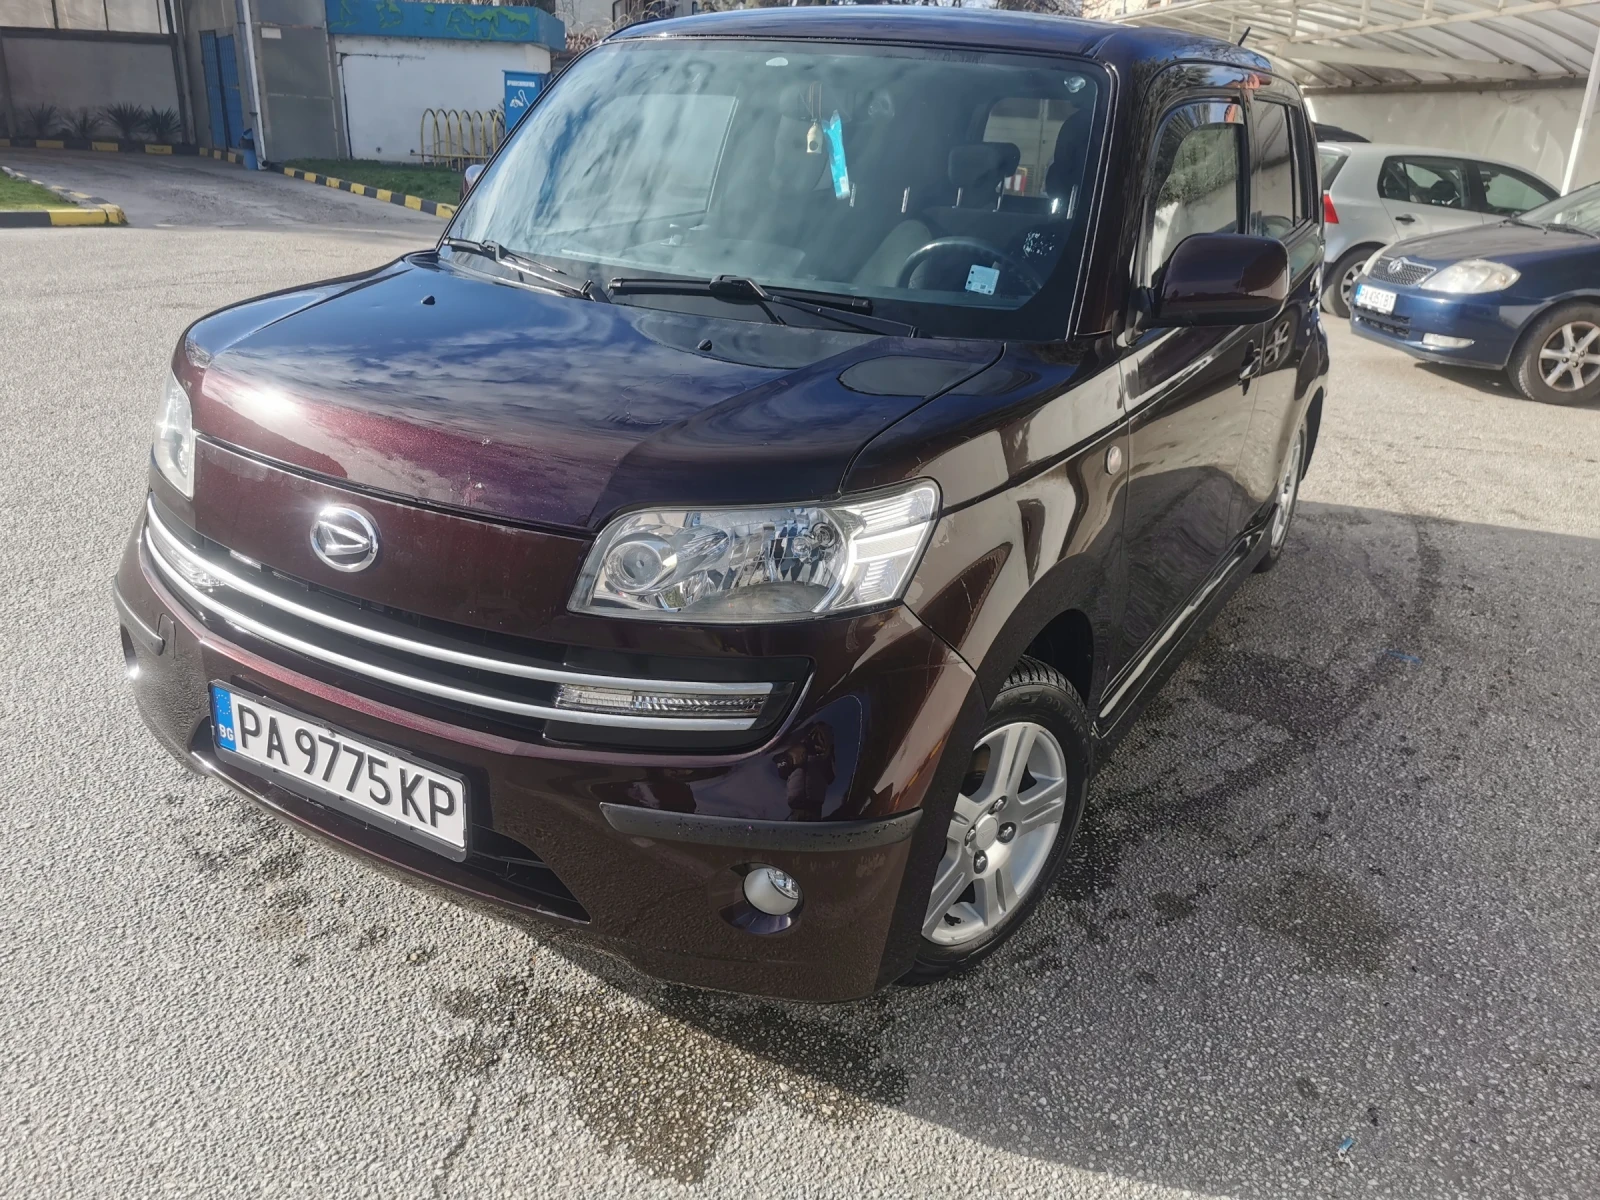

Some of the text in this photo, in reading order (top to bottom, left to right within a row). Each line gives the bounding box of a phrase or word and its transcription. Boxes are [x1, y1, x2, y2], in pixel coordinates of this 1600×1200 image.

[219, 723, 234, 741] BG
[238, 703, 456, 828] PA 9775 KP
